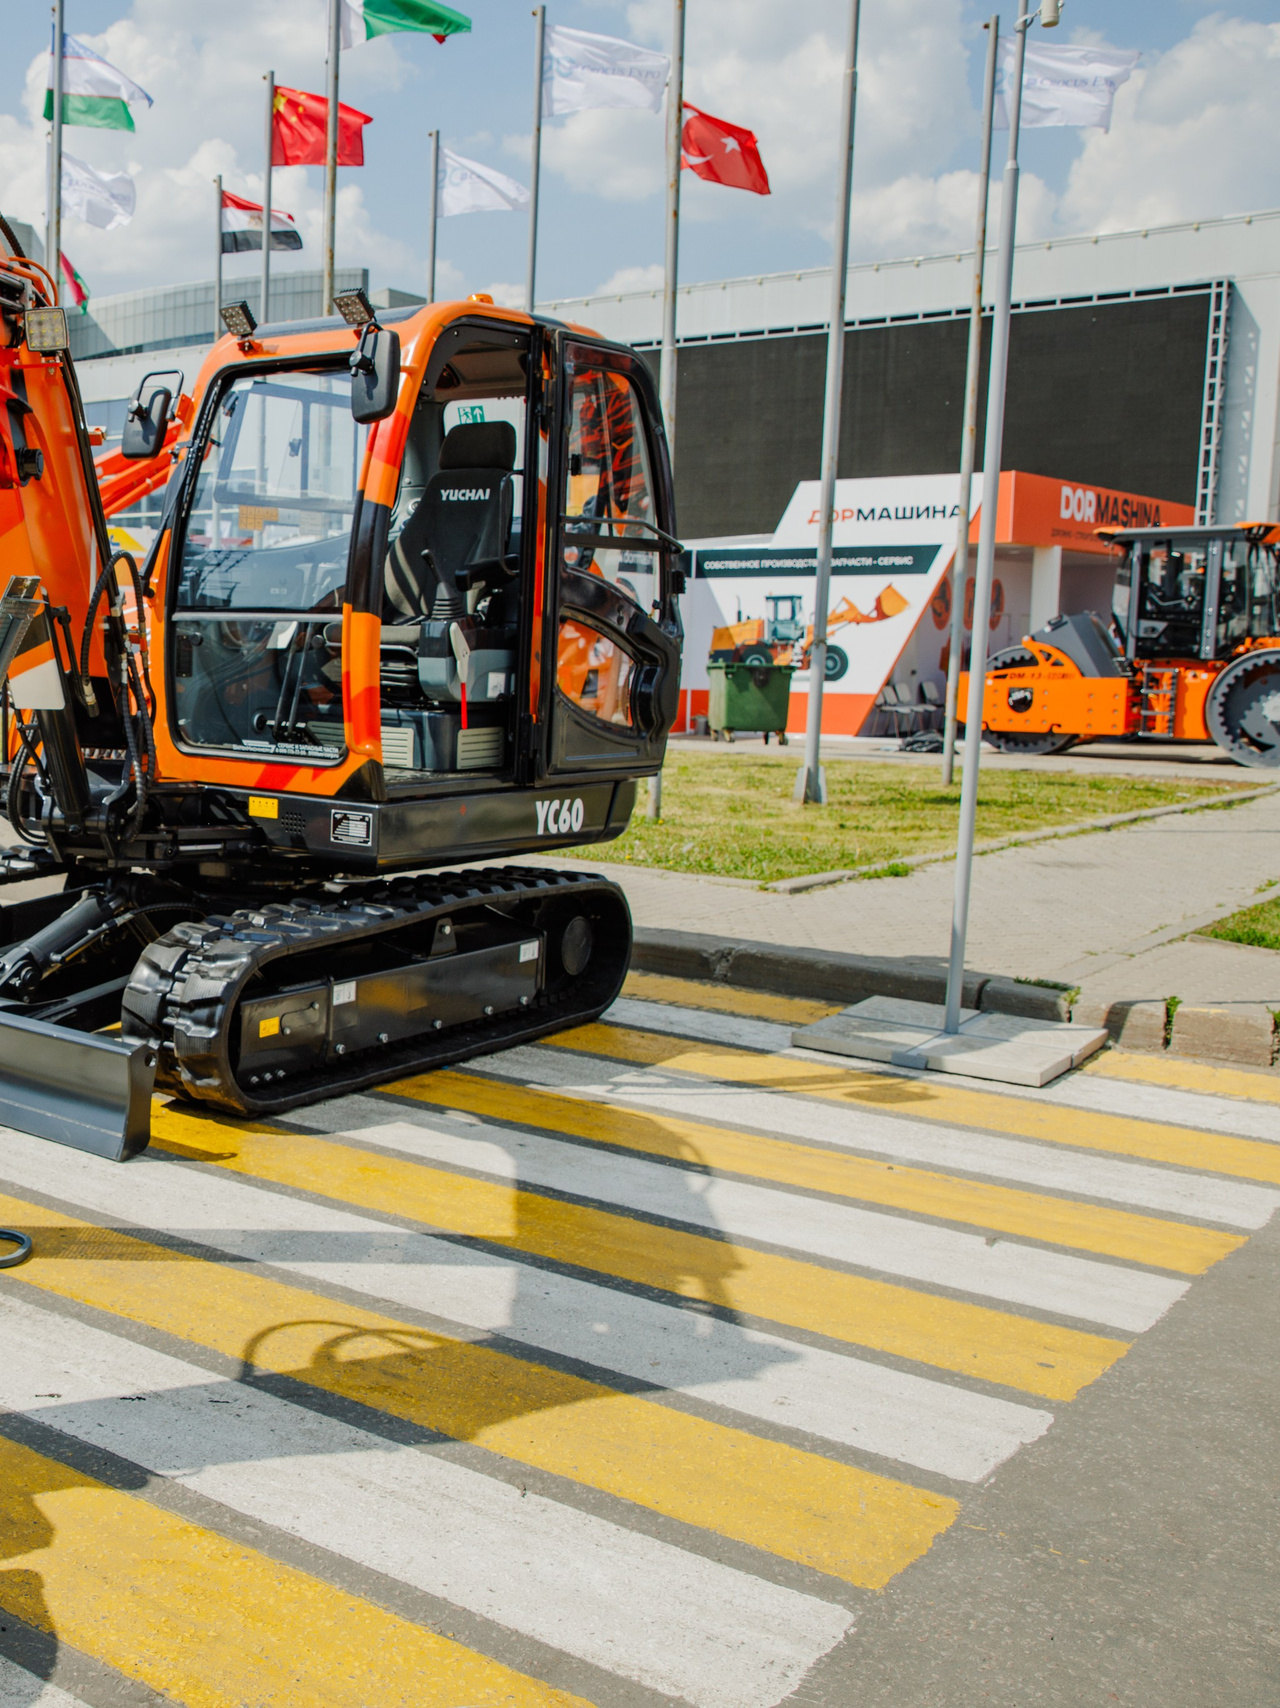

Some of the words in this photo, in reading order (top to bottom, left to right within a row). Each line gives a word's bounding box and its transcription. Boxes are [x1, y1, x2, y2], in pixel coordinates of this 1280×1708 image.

[440, 488, 490, 501] YUCHAI
[1060, 485, 1161, 528] DORMASHINA
[877, 555, 913, 567] СЕРВИС
[535, 798, 584, 836] YC60
